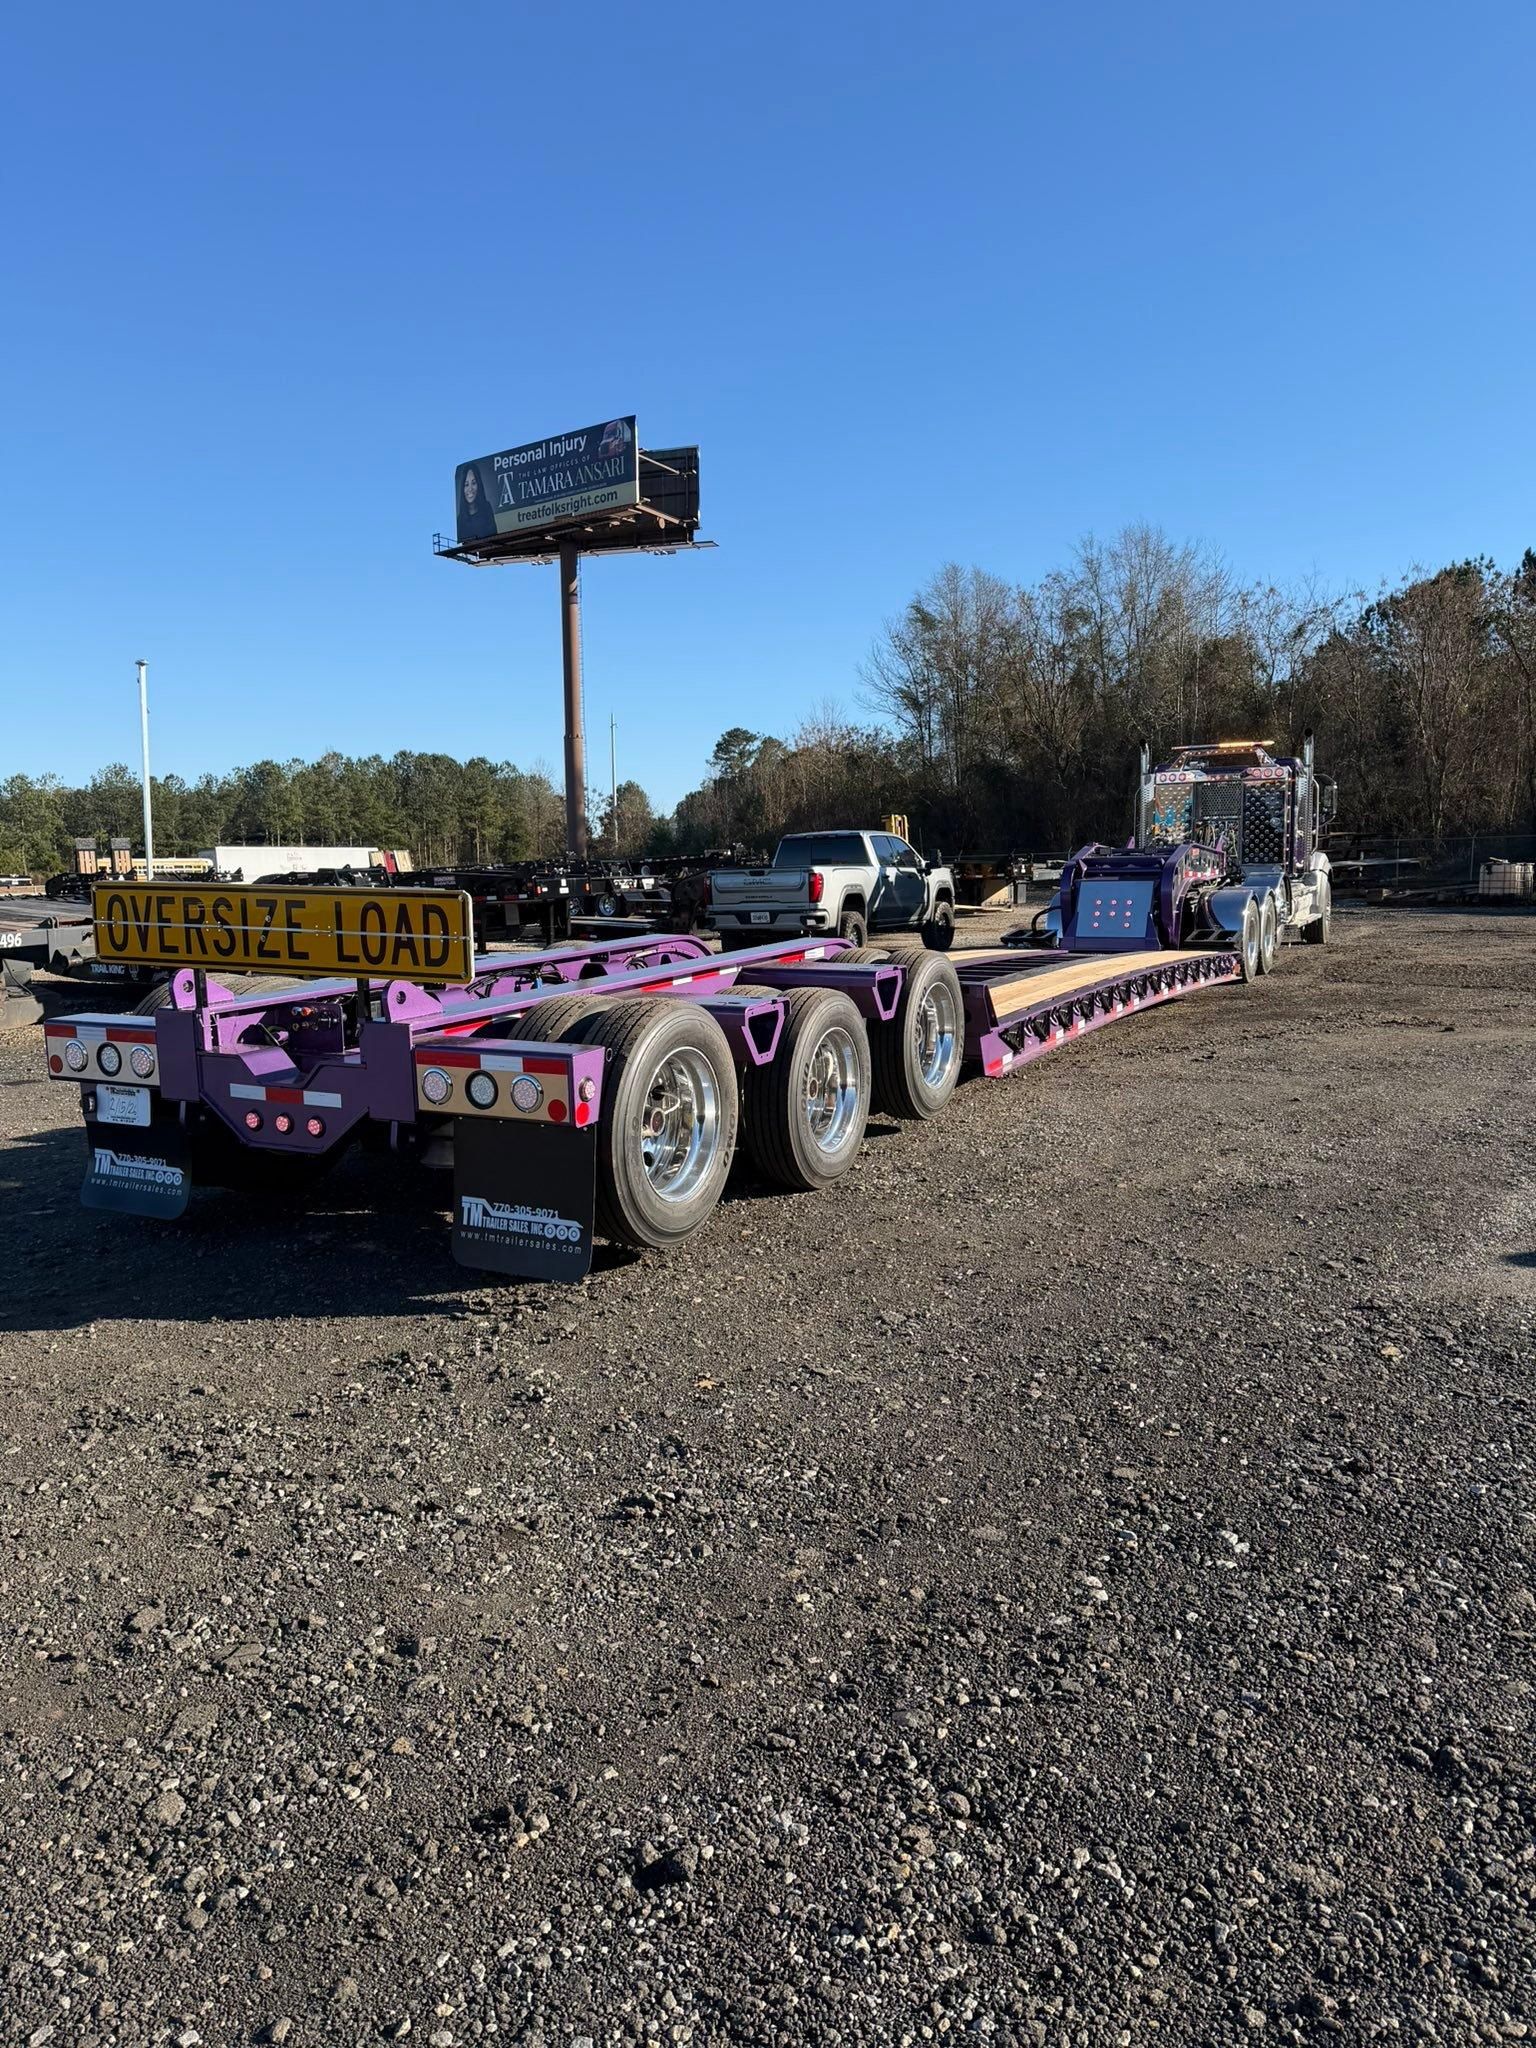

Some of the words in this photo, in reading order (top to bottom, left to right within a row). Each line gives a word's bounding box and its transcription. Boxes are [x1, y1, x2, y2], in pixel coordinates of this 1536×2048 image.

[494, 442, 546, 471] Personal
[549, 435, 587, 457] Injury
[533, 466, 547, 476] LAW
[550, 459, 579, 471] OFFICES
[581, 454, 591, 463] OF
[518, 470, 574, 499] TAMARA
[574, 456, 625, 485] ANSARI
[517, 490, 618, 523] treatfolksright.com
[106, 893, 310, 961] OVERSIZE
[334, 900, 450, 967] LOAD
[90, 964, 109, 973] TRAIL
[109, 964, 126, 974] KING
[94, 1153, 111, 1175] TM
[110, 1165, 129, 1177] TRAILER
[118, 1153, 166, 1167] 770-305-9071
[91, 1178, 182, 1196] www.tmtrailersales.com
[461, 1202, 483, 1227] TM
[493, 1202, 560, 1219] 770-305-9071
[482, 1216, 508, 1231] TRAILER
[460, 1230, 582, 1254] www.tmtrailersales.com
